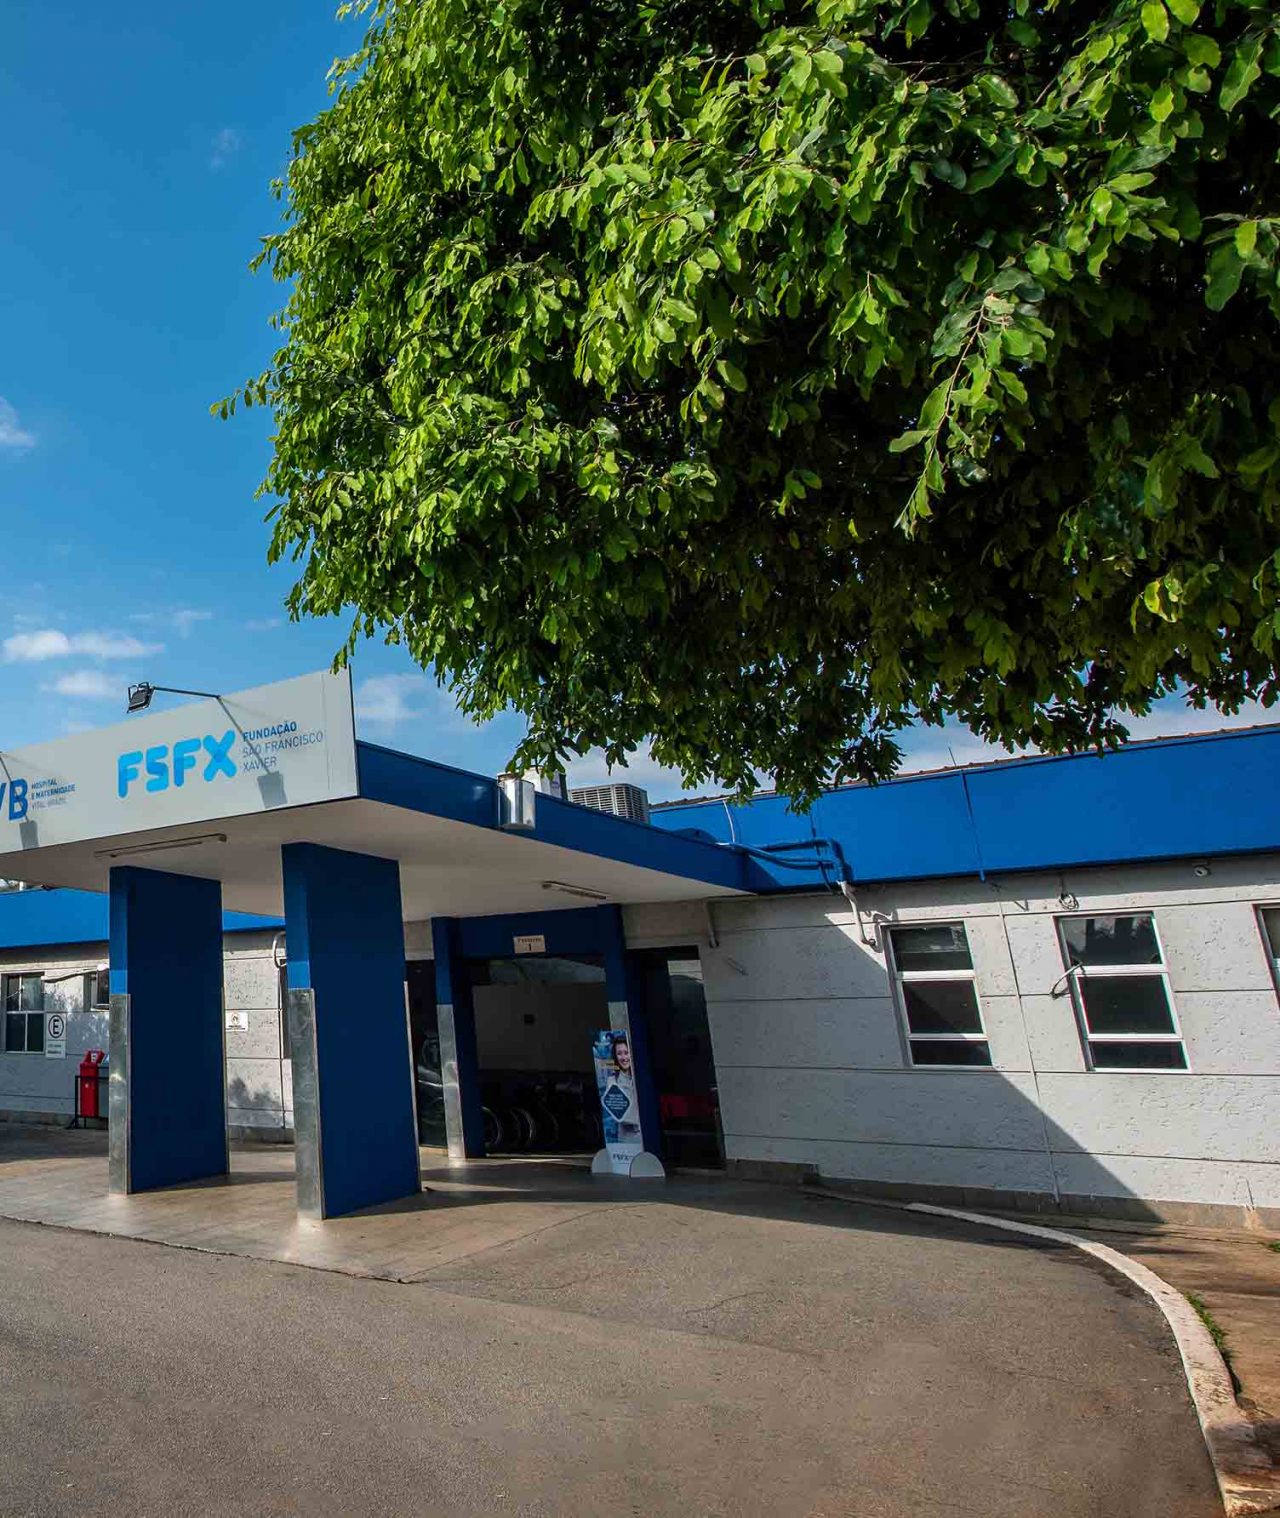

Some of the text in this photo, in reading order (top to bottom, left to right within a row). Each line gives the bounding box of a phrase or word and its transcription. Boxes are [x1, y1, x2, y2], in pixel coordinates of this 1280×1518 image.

[242, 720, 297, 742] FUNDAÇÃO
[265, 731, 324, 753] FRANCISCO
[118, 730, 237, 798] FSFX
[243, 756, 277, 772] XAVIER
[31, 778, 57, 789] HOSPITAL
[36, 784, 75, 799] MATERNIDADE
[52, 1019, 60, 1035] E
